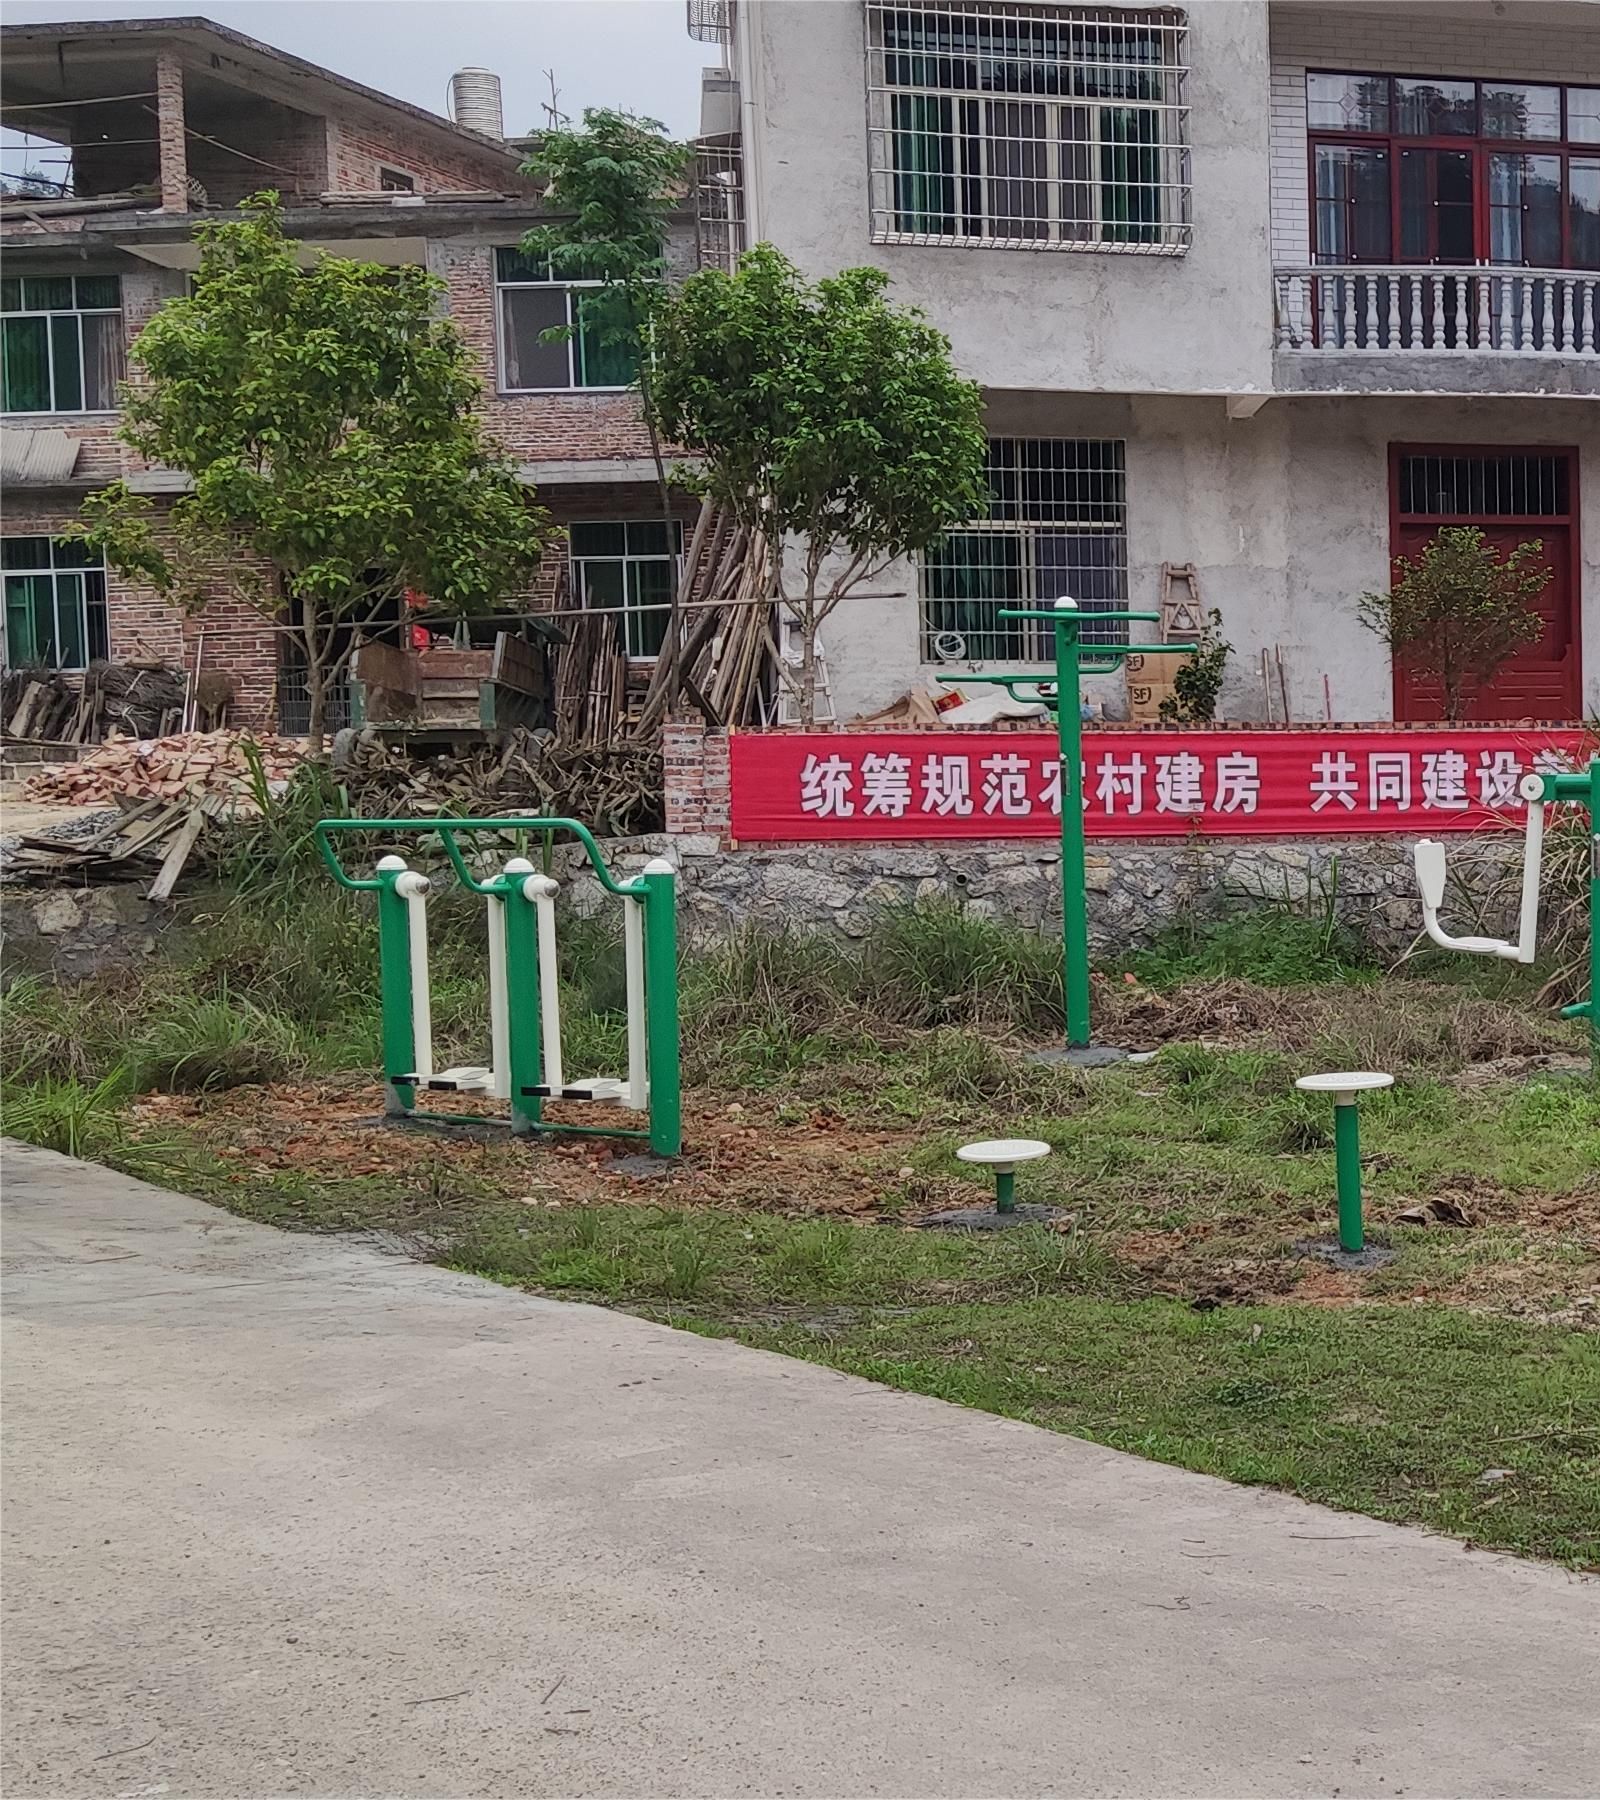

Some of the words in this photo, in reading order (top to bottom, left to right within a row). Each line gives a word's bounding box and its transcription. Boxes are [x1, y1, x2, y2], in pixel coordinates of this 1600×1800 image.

[799, 752, 1261, 818] 统筹规范农村建房
